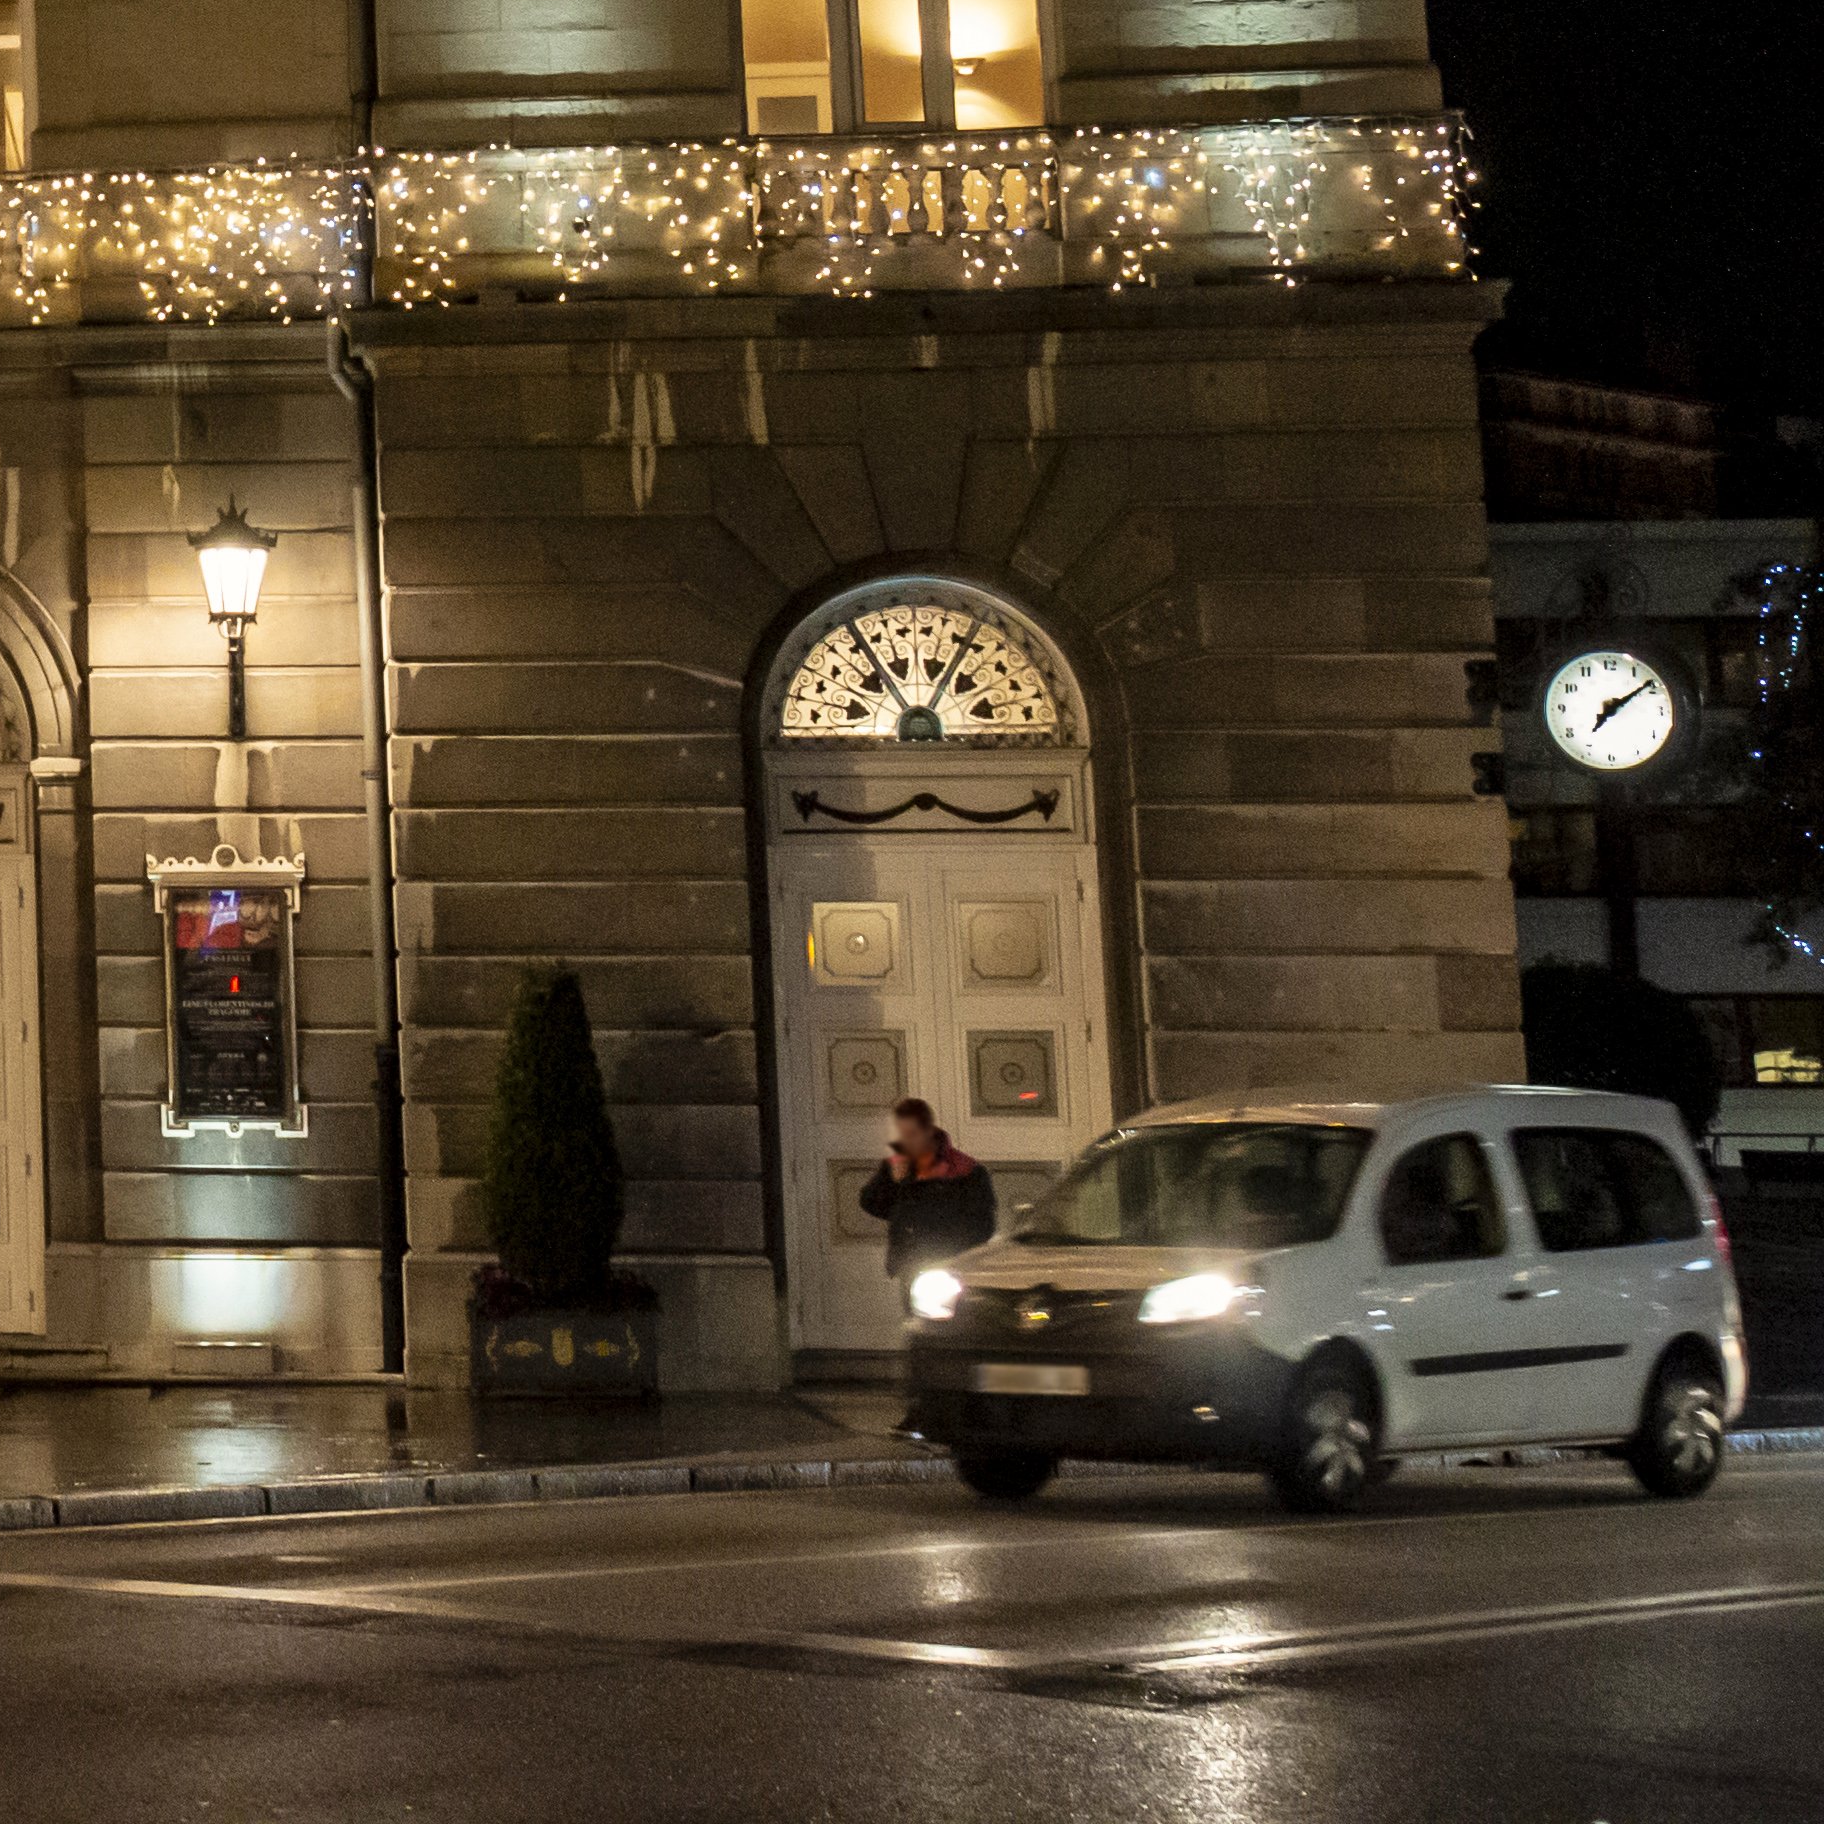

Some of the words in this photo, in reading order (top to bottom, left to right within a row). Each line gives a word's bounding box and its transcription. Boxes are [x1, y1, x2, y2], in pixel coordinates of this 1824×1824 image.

[1603, 660, 1617, 671] 12
[1581, 666, 1591, 677] 11
[1632, 666, 1637, 677] 1
[1564, 683, 1578, 694] 10
[1558, 704, 1566, 714] 9
[1566, 728, 1574, 738] 8
